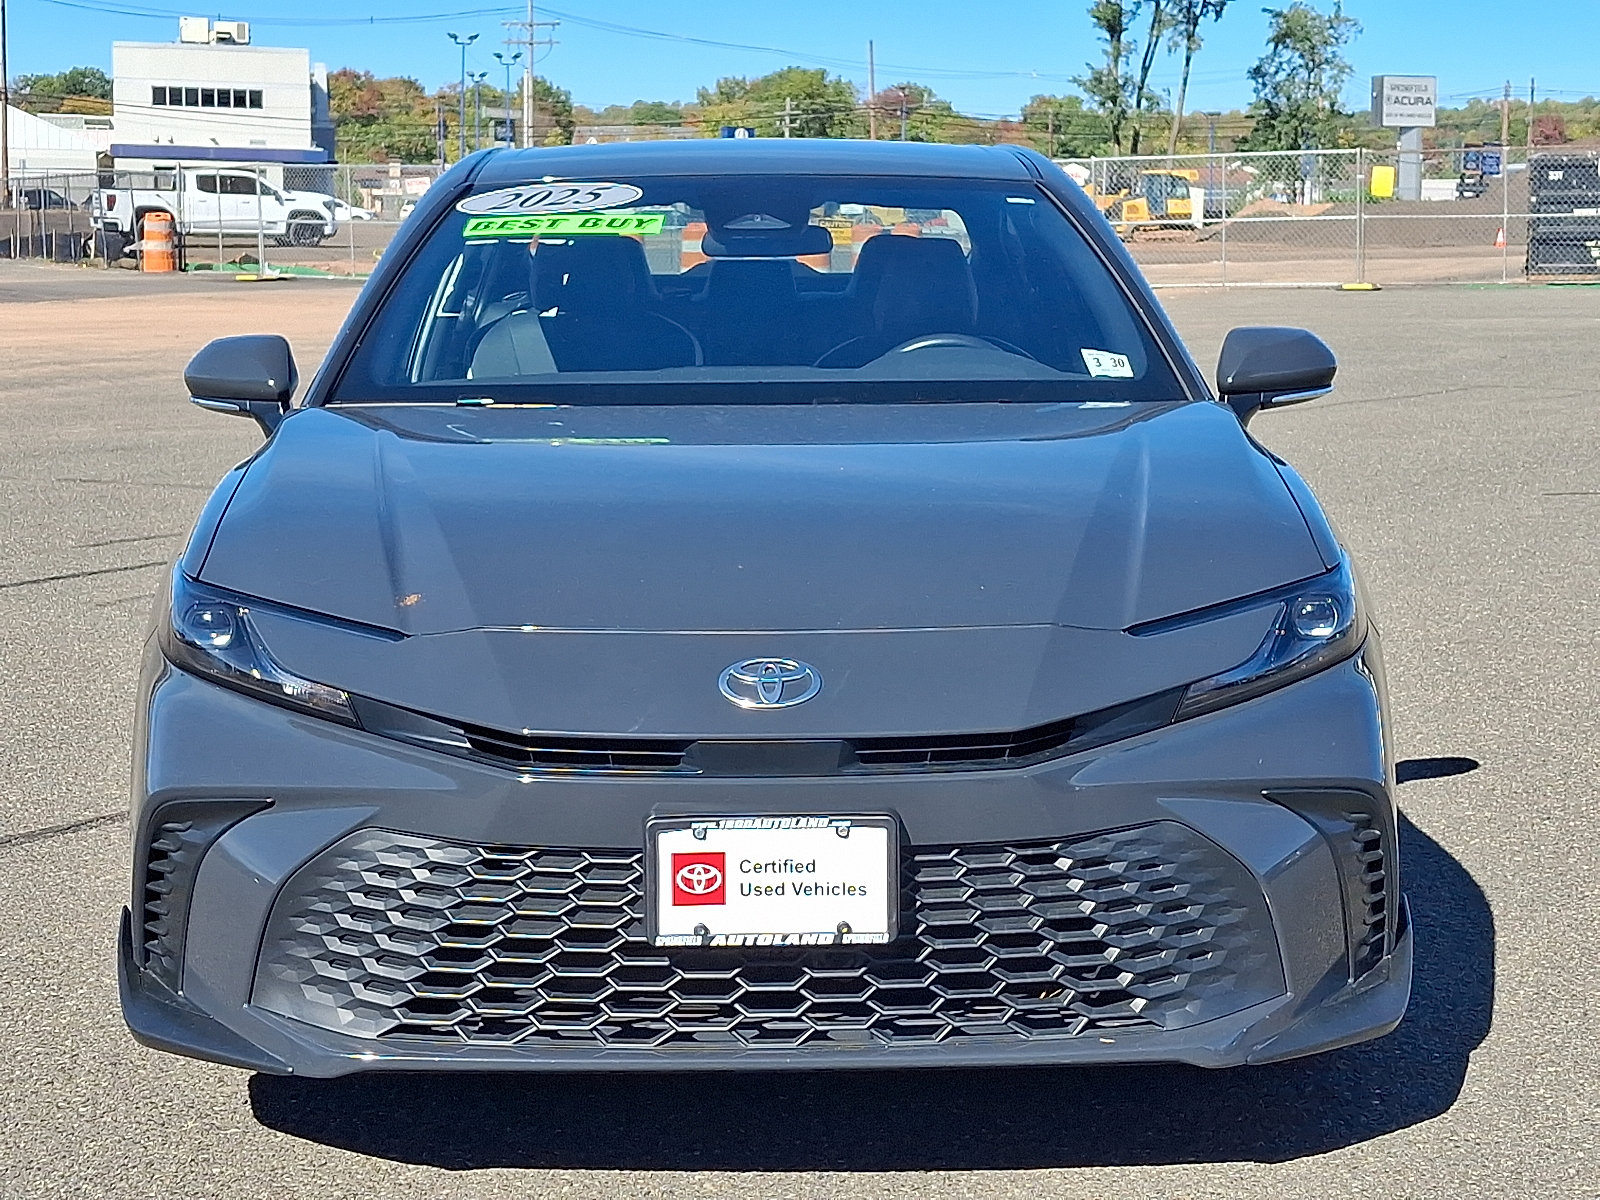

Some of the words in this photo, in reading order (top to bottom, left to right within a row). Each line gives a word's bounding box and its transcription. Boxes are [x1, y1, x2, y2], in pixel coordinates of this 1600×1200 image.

[1393, 95, 1433, 106] ACURA
[486, 187, 612, 210] 2025
[469, 218, 569, 232] BEST
[578, 217, 659, 229] BUY
[820, 220, 852, 228] CAUTION
[1092, 357, 1102, 368] 3
[1110, 357, 1125, 368] 30
[719, 816, 830, 829] 1800AUTOLAND
[739, 859, 816, 874] Certified
[740, 882, 785, 896] Used
[792, 882, 867, 896] Vehicles
[709, 933, 835, 947] AUTOLAND
